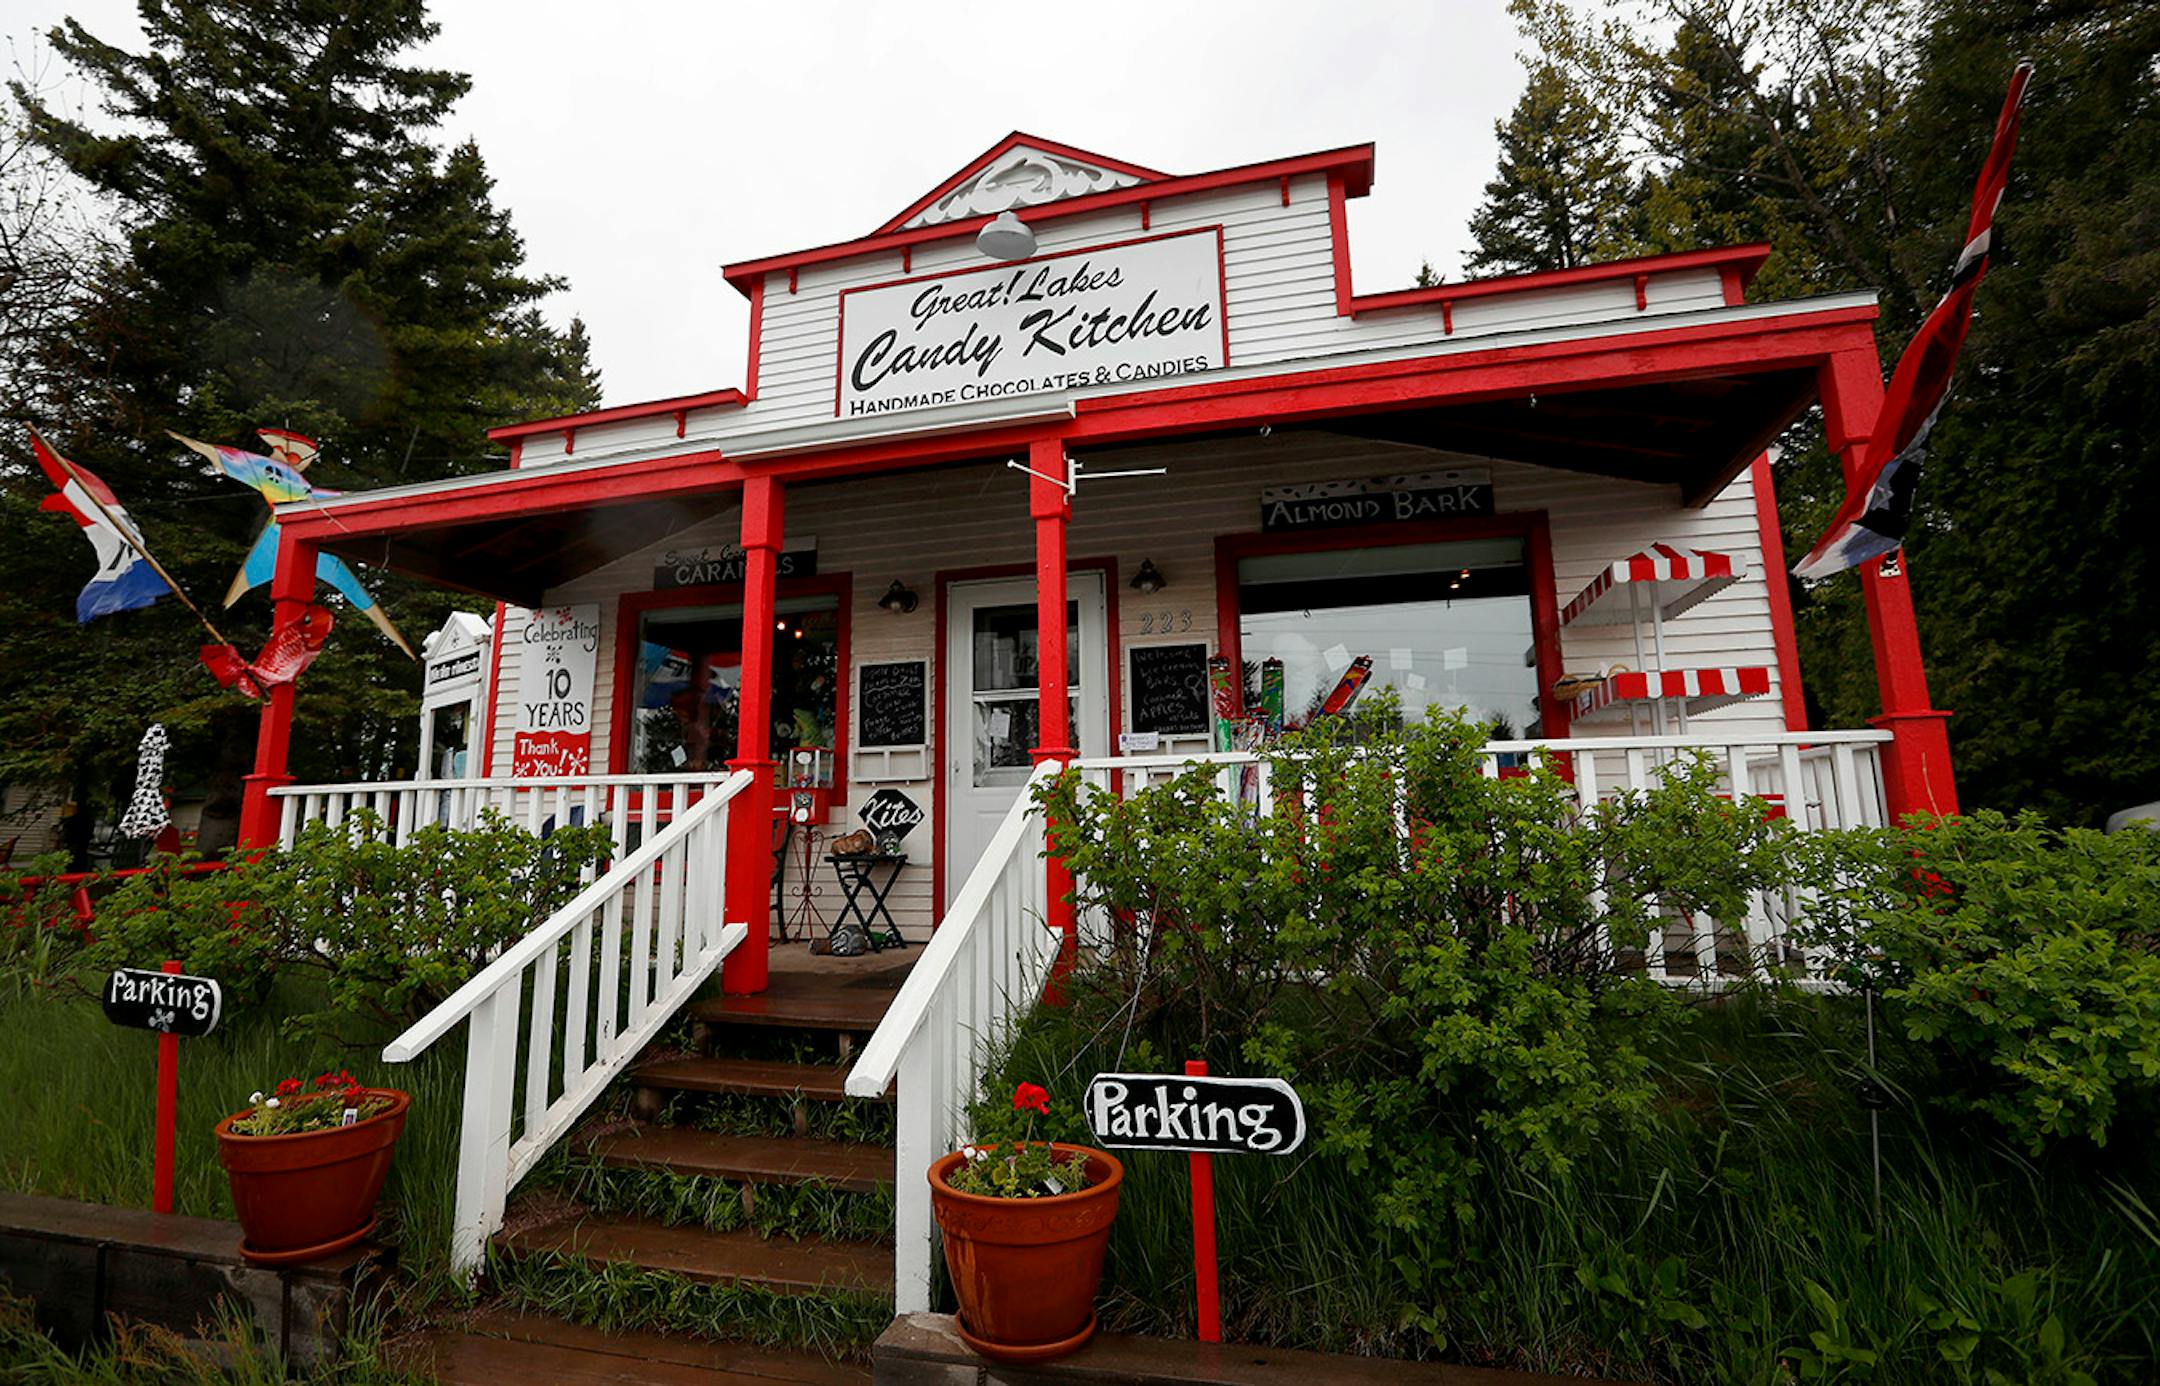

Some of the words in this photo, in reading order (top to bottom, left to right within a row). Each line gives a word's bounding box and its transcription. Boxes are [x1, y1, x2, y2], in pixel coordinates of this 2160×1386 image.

[1015, 261, 1124, 304] Lakes
[851, 322, 1001, 390] Candy
[1019, 290, 1212, 357] Kitchen
[850, 389, 956, 416] HANDMADE
[960, 370, 1090, 400] CHOCOLATES
[1095, 366, 1111, 383] &
[1116, 356, 1208, 380] CANDIES
[1268, 501, 1381, 526] ALMOND
[1392, 486, 1481, 520] BARK
[675, 556, 795, 585] CARAS
[524, 620, 598, 653] Celebrating
[1140, 608, 1193, 634] 223
[545, 668, 572, 700] 10
[526, 701, 585, 727] YEARS
[519, 738, 559, 756] Thank
[864, 797, 922, 830] Kites
[110, 970, 211, 1021] Parking
[1093, 1080, 1283, 1150] Parking
